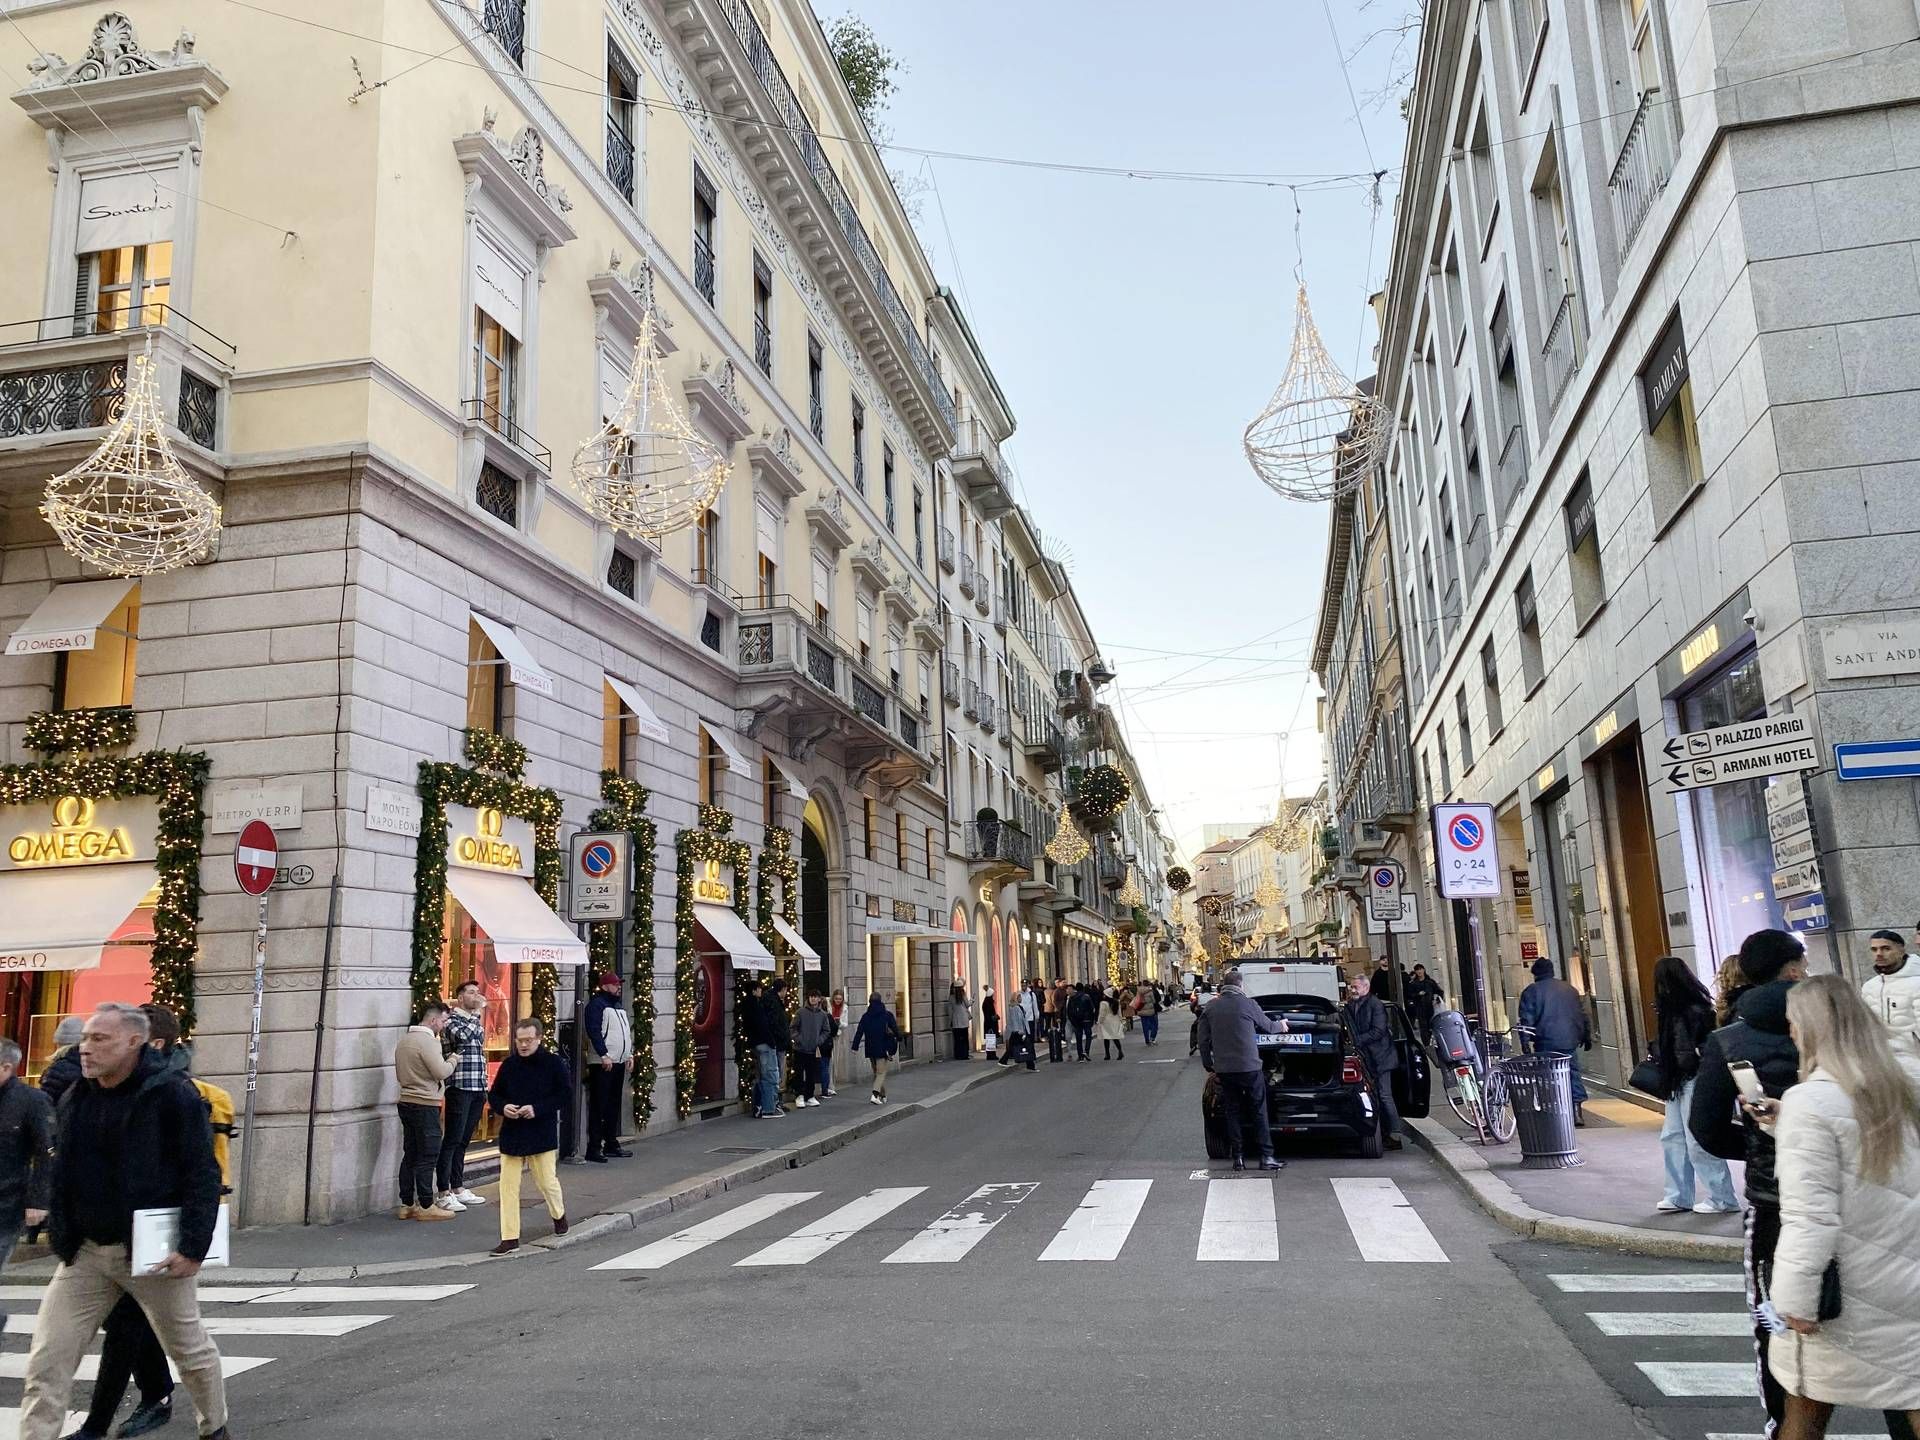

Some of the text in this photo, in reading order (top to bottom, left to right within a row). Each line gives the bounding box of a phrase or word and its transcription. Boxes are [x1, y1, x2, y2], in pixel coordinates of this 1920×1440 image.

[1653, 345, 1684, 411] DAMIANI
[31, 638, 71, 650] OMEGA
[1877, 632, 1898, 640] VIA
[1715, 719, 1804, 746] PALAZZO PARIGI
[1723, 748, 1815, 774] ARMANI HOTEL
[9, 828, 129, 862] OMEGA
[459, 837, 523, 869] OMEGA
[1471, 860, 1486, 869] 24
[598, 886, 609, 894] 24
